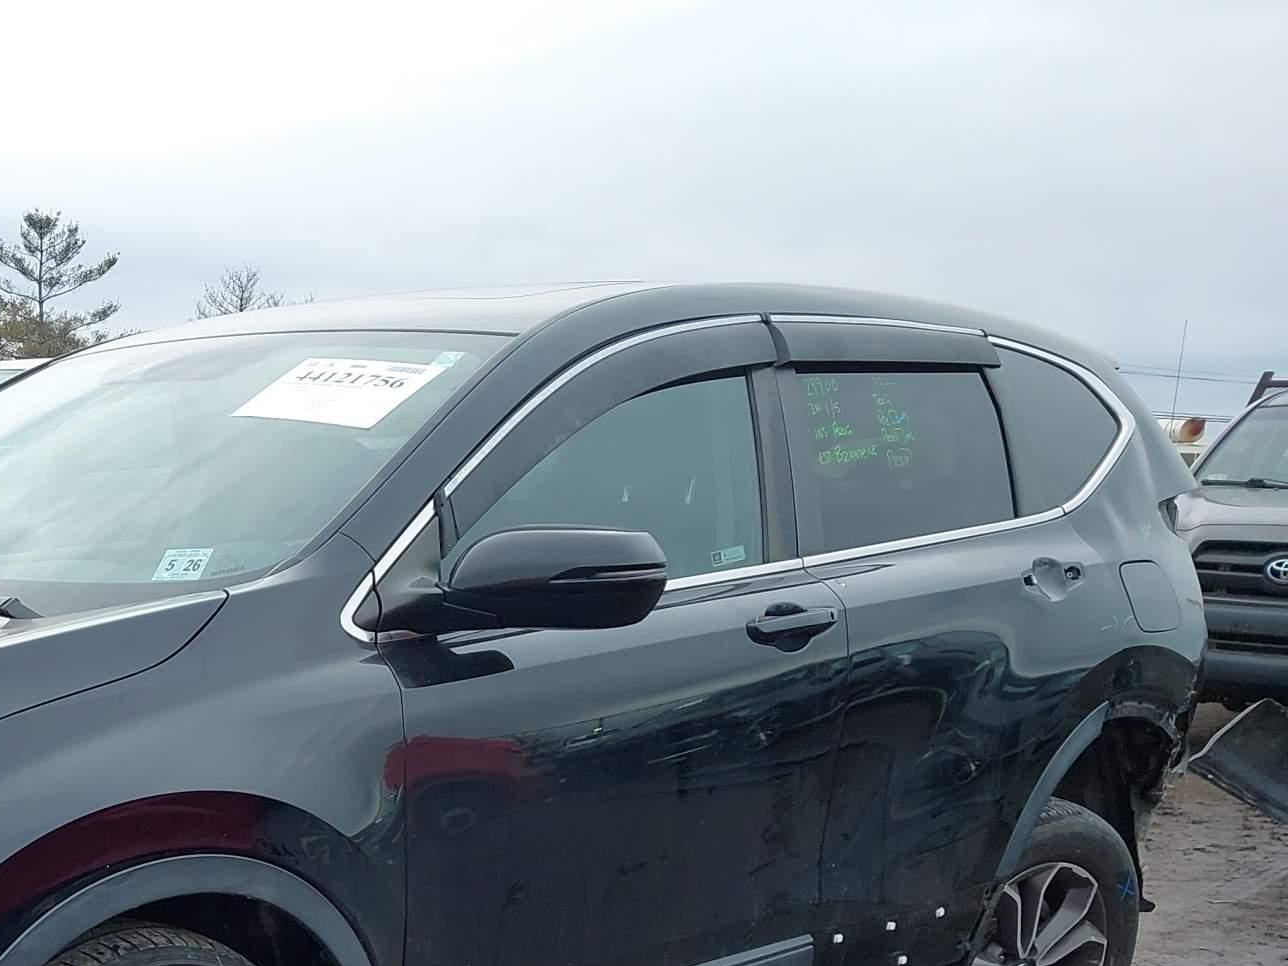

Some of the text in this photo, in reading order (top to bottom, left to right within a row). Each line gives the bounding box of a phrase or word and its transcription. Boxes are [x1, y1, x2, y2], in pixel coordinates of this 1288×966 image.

[295, 369, 407, 389] 44121756
[165, 558, 178, 572] 5
[182, 558, 203, 572] 26
